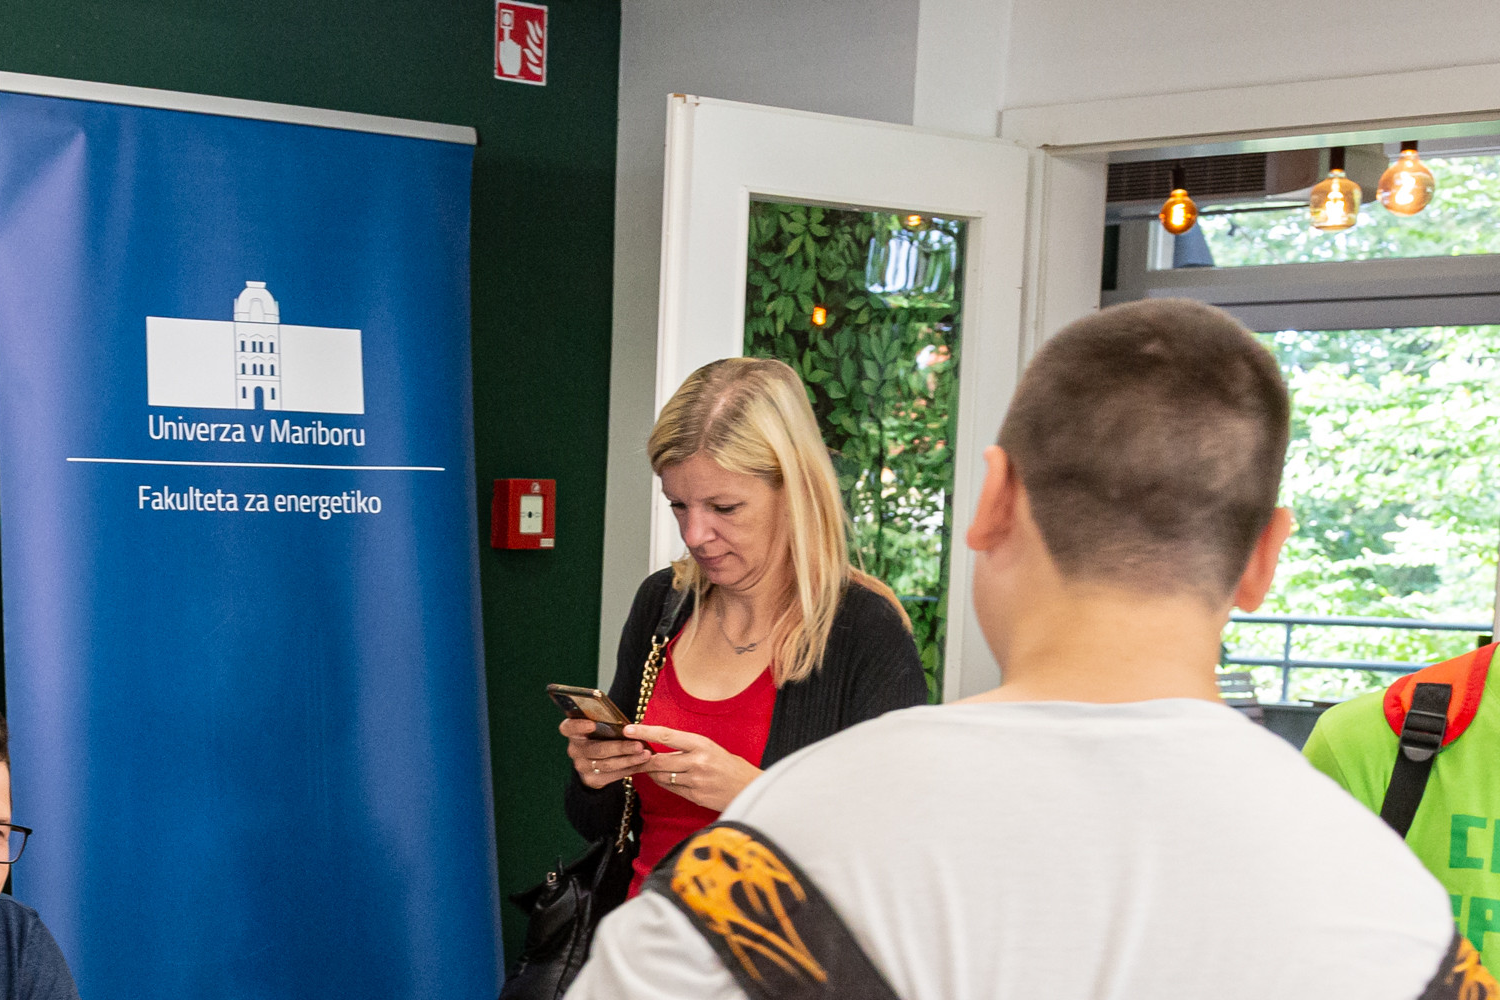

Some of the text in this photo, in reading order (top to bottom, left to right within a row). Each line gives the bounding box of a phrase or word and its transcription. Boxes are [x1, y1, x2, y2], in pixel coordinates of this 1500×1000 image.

[148, 415, 366, 446] Univerza v Mariboru
[138, 485, 382, 520] Fakulteta za energetiko
